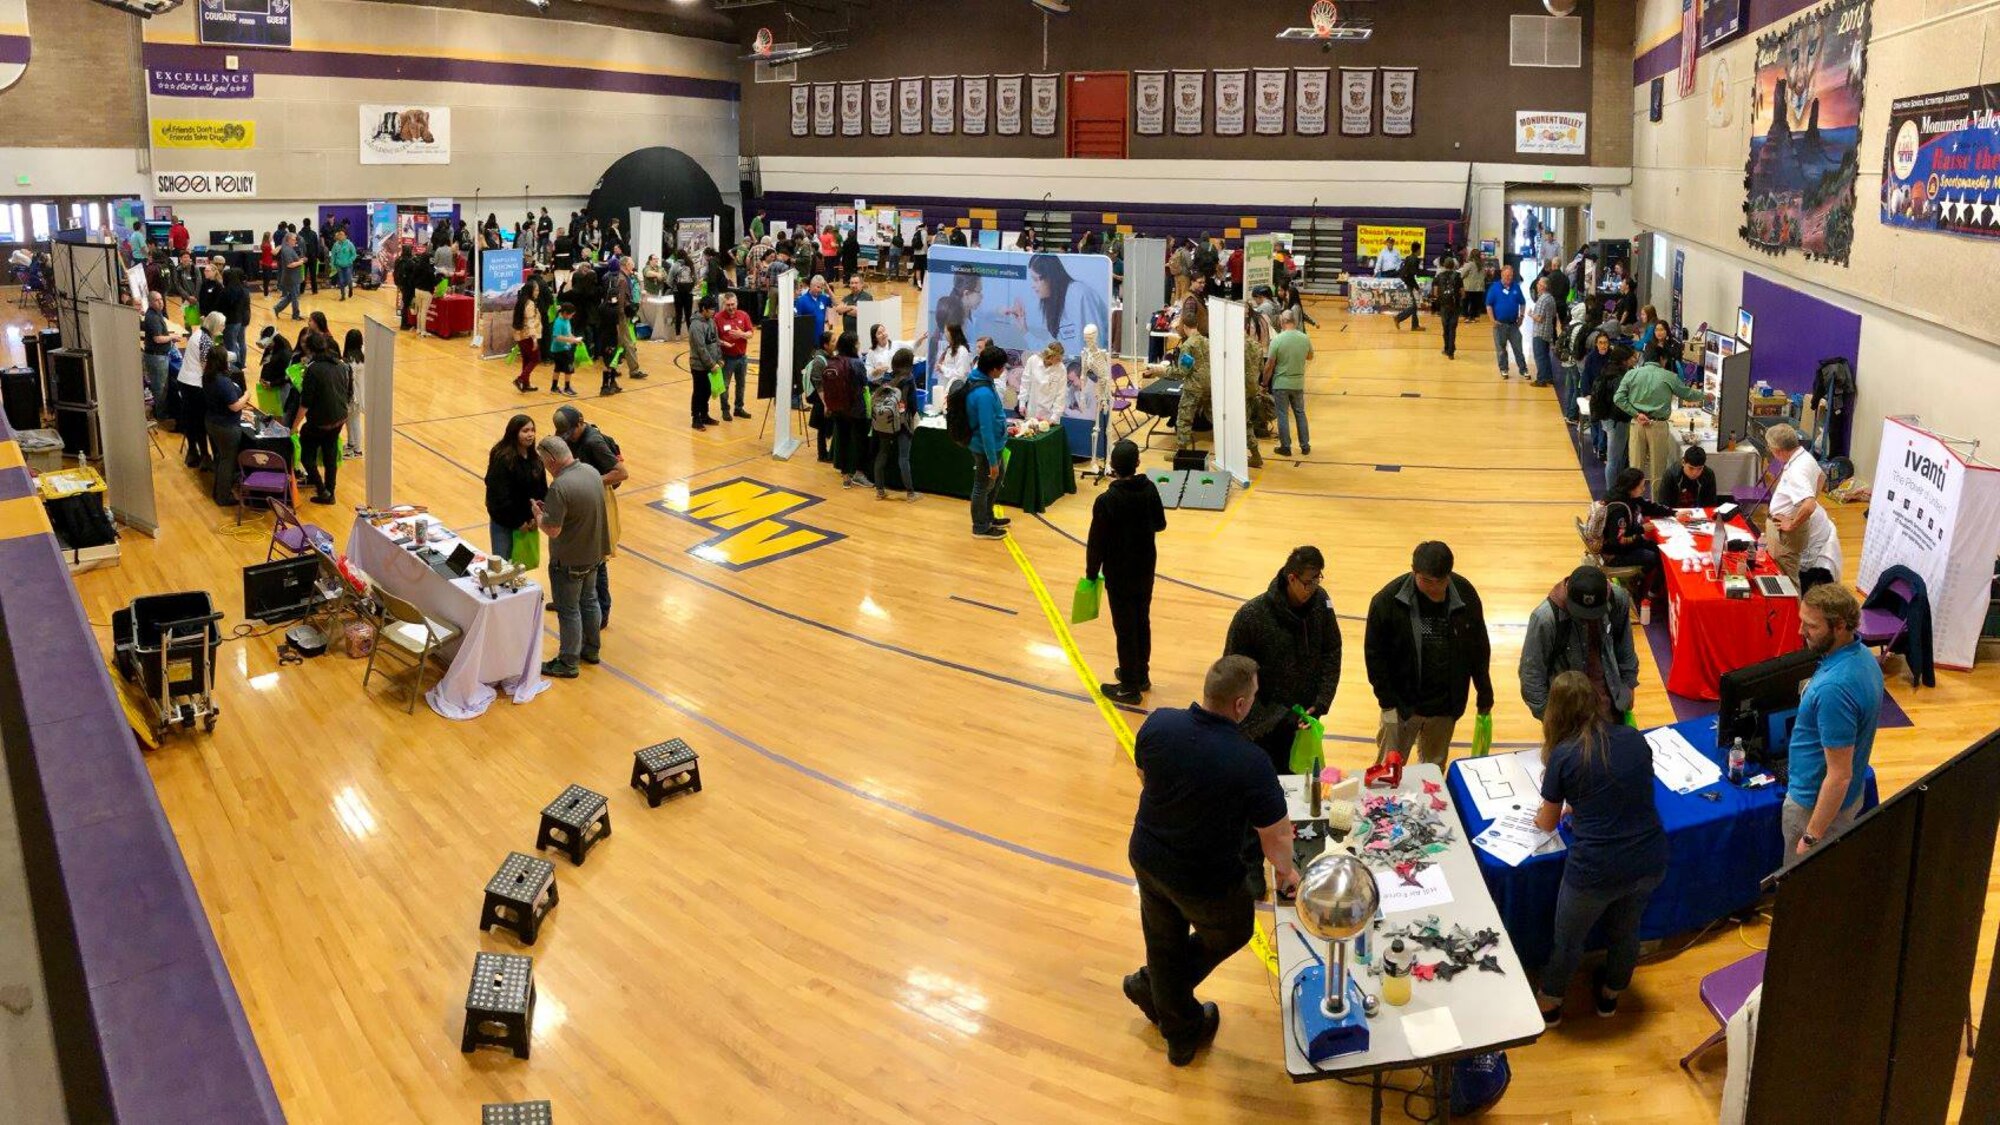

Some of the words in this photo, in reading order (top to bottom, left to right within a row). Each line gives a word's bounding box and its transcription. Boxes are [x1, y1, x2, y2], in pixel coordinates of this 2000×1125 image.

[205, 11, 237, 21] COUGARS
[266, 16, 288, 25] GUEST
[1837, 3, 1866, 35] 2018
[155, 71, 249, 83] EXCELLENCE
[176, 82, 198, 91] starts
[199, 83, 213, 92] with
[1520, 115, 1558, 127] MONUMENT
[1559, 116, 1583, 128] VALLEY
[1920, 115, 1969, 134] Monument
[172, 126, 195, 134] Friends
[196, 126, 212, 134] Don't
[169, 133, 193, 141] Friends
[194, 133, 209, 141] Take
[1931, 147, 1971, 170] Raise
[158, 175, 211, 193] SCHOOL
[215, 175, 253, 193] POLICY
[1940, 174, 1990, 191] Sportsmanship
[972, 265, 998, 275] science
[1904, 439, 1949, 493] ivanti
